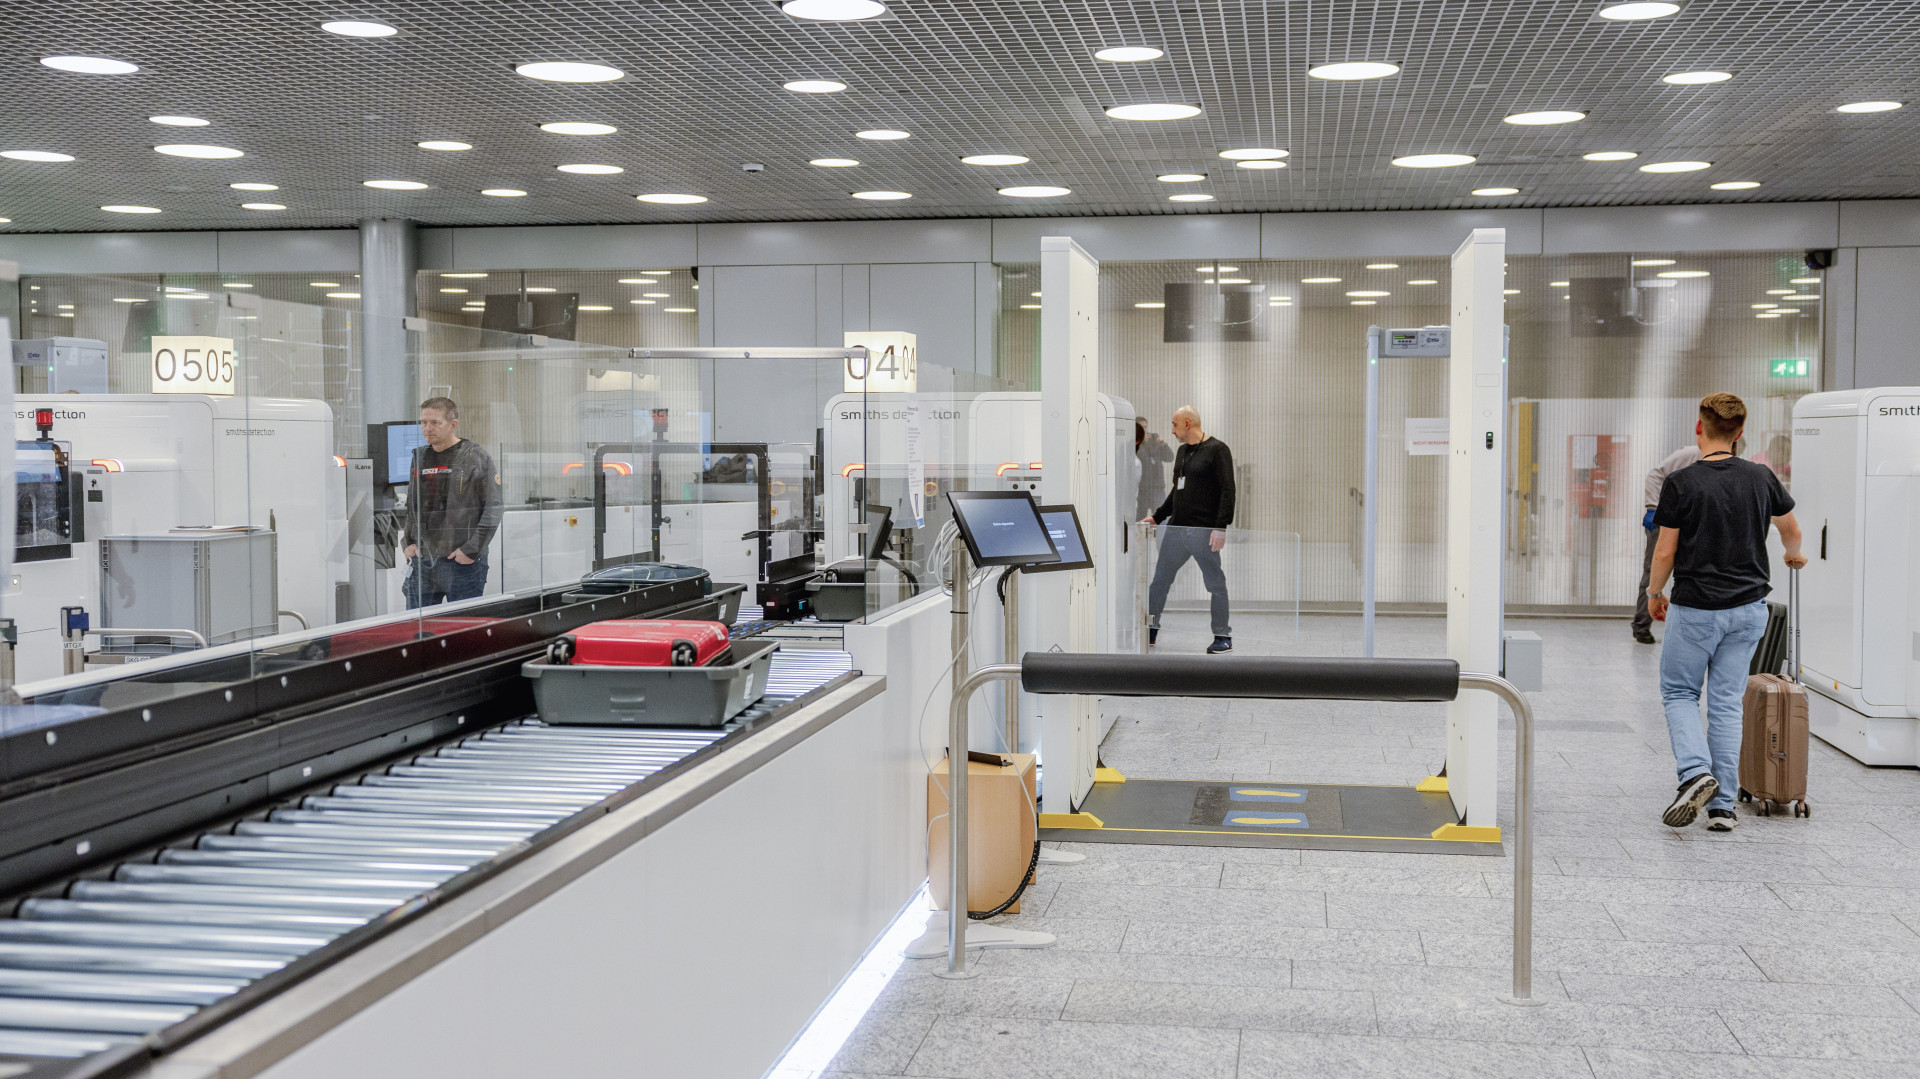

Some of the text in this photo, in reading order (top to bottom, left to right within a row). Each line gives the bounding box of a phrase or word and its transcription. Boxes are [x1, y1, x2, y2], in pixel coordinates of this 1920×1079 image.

[155, 348, 203, 382] 05
[206, 349, 233, 383] 05
[847, 344, 899, 380] 04
[225, 427, 246, 436] smiths
